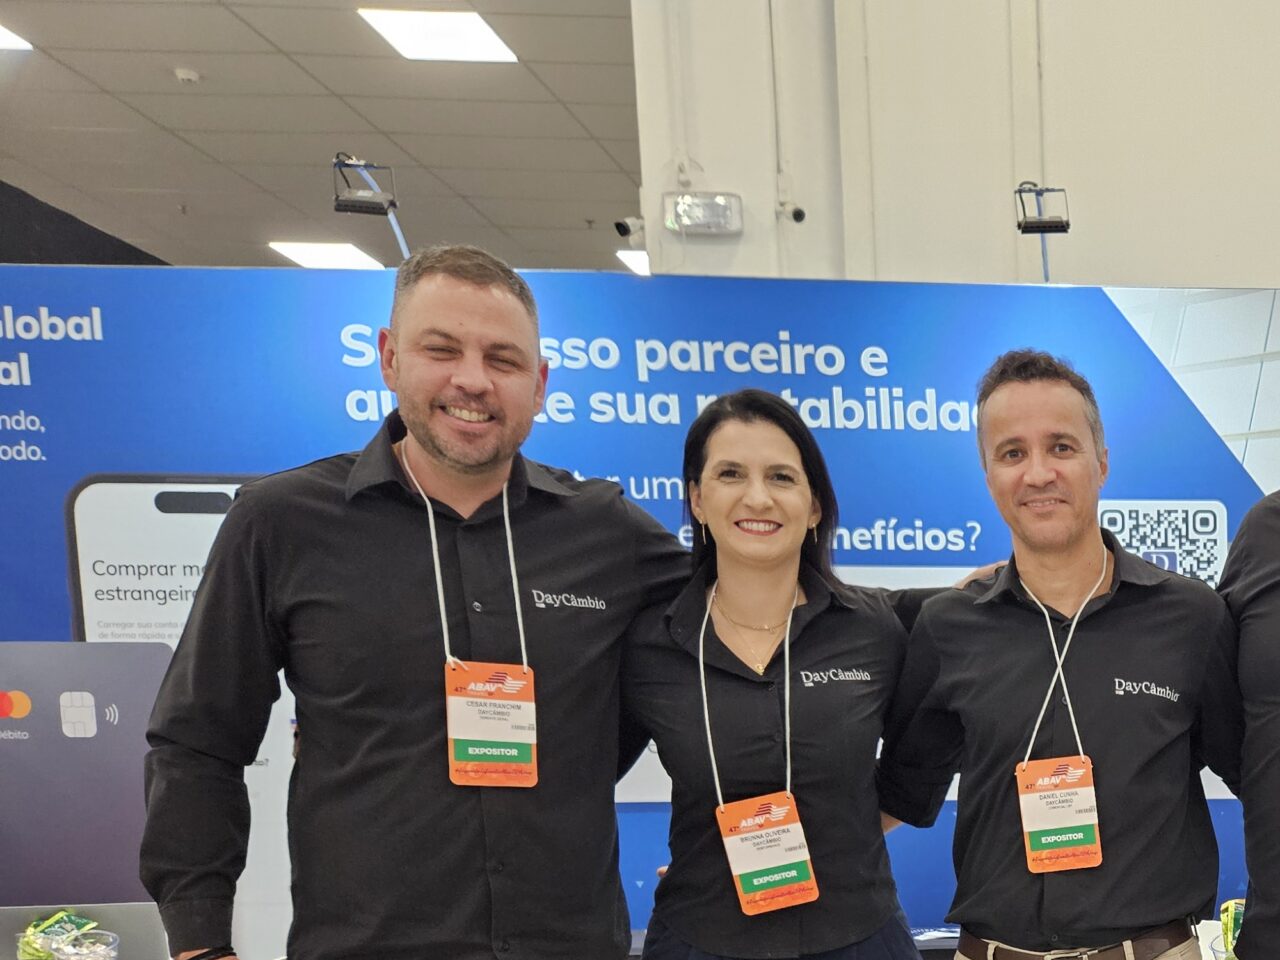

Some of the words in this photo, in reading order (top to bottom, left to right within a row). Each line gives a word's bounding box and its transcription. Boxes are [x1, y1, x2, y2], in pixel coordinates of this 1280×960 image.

[0, 305, 104, 341] lobal
[635, 330, 846, 382] parceiro
[860, 346, 889, 376] e
[589, 392, 681, 426] sua
[92, 560, 177, 580] Comprar
[531, 589, 606, 609] DayCâmbio
[800, 668, 871, 685] DayCâmbio
[1114, 678, 1180, 702] DayCâmbio
[468, 747, 518, 756] EXPOSITOR
[1036, 776, 1062, 785] ABAV
[740, 815, 766, 827] ABAV
[1041, 833, 1084, 844] EXPOSITOR
[753, 870, 798, 886] EXPOSITOR
